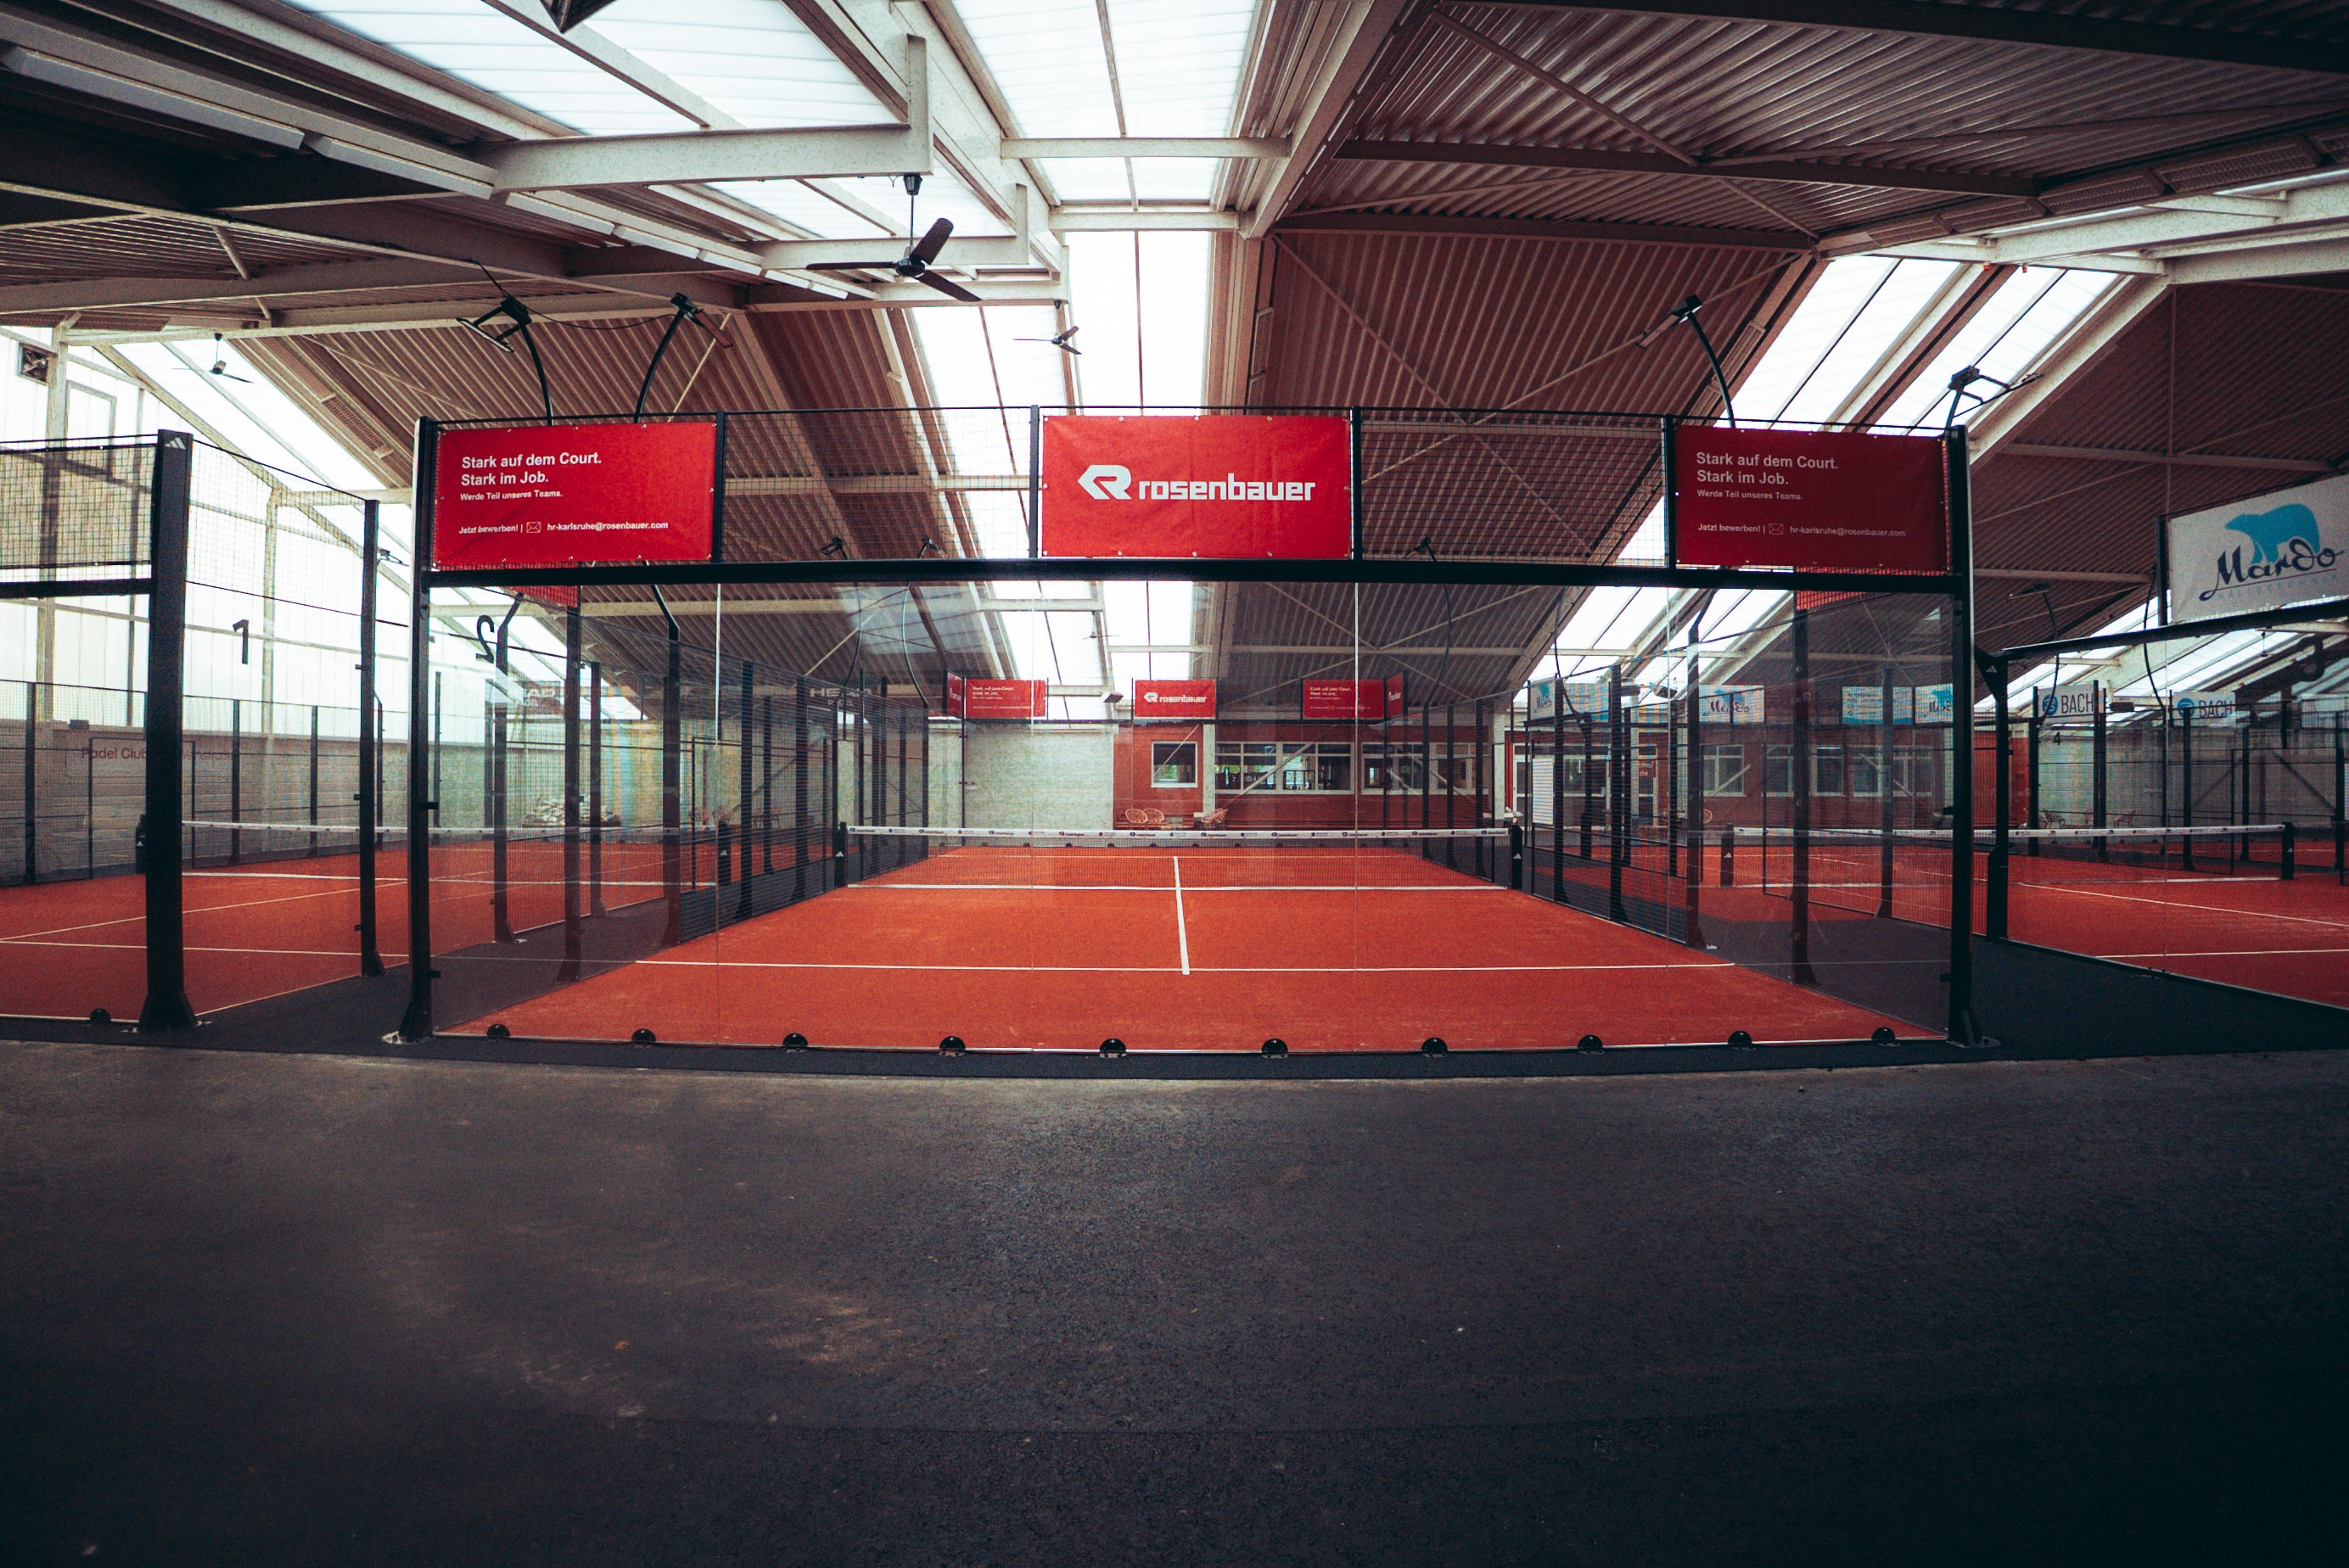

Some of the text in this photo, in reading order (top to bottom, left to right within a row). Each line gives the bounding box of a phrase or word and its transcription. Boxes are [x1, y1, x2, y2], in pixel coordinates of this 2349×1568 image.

[462, 451, 602, 468] Stark auf dem Court.
[1696, 452, 1839, 468] Stark auf dem Court.
[461, 471, 549, 486] Stark im Job.
[1696, 469, 1789, 484] Stark im Job.
[1139, 473, 1315, 501] rosenbauer
[1696, 489, 1723, 497] Werde
[1724, 490, 1740, 498] Teil
[460, 492, 484, 501] Werde
[486, 491, 500, 500] Teil
[1697, 523, 1718, 531] Jetzt
[2199, 536, 2344, 602] Mardo
[233, 619, 249, 664] 1
[2061, 692, 2094, 714] BACH
[2199, 699, 2233, 718] BACH
[2053, 731, 2061, 745] 4
[82, 747, 117, 759] Padel
